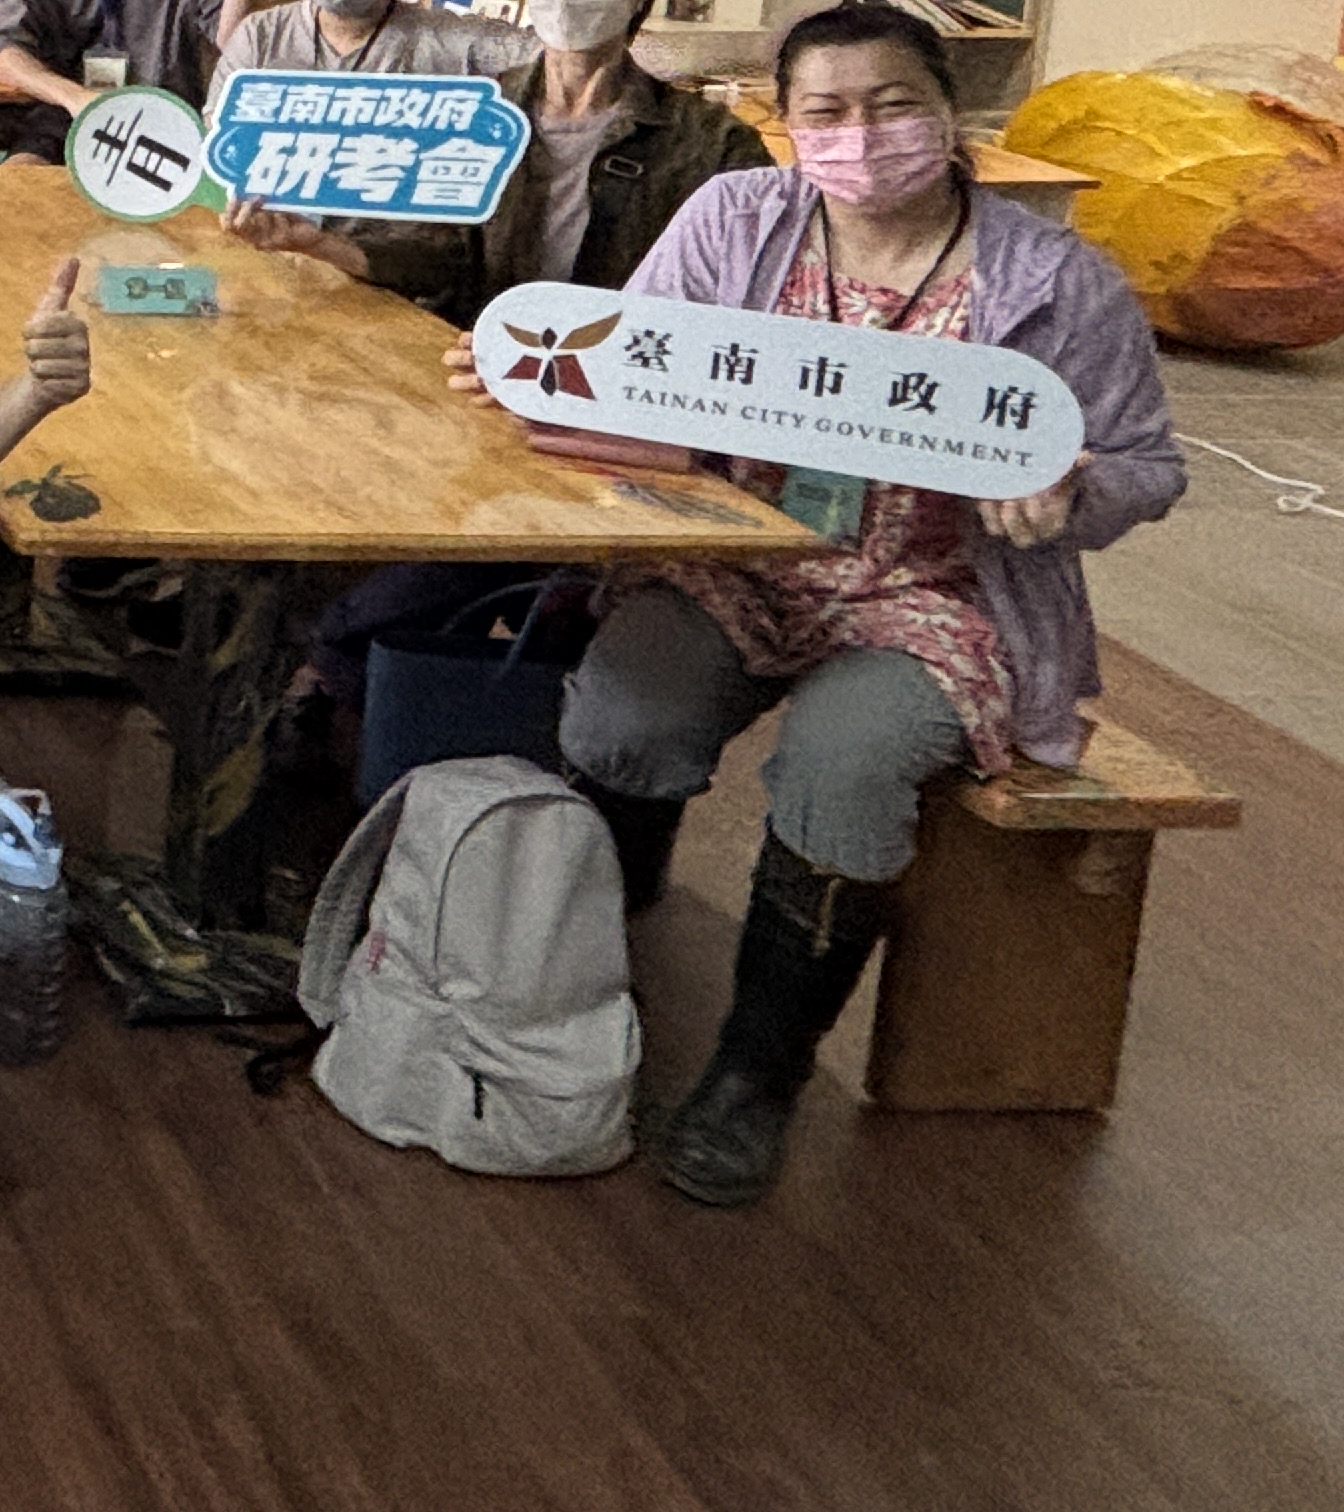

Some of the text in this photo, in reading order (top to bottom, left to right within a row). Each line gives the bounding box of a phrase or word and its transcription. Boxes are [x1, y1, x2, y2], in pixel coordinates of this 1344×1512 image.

[228, 81, 484, 132] 臺南市政府
[90, 108, 191, 193] 青
[244, 131, 506, 208] 研考會
[621, 328, 1041, 431] 臺南市政府
[622, 383, 1033, 468] TAINAN CITY GOVERNMENT
